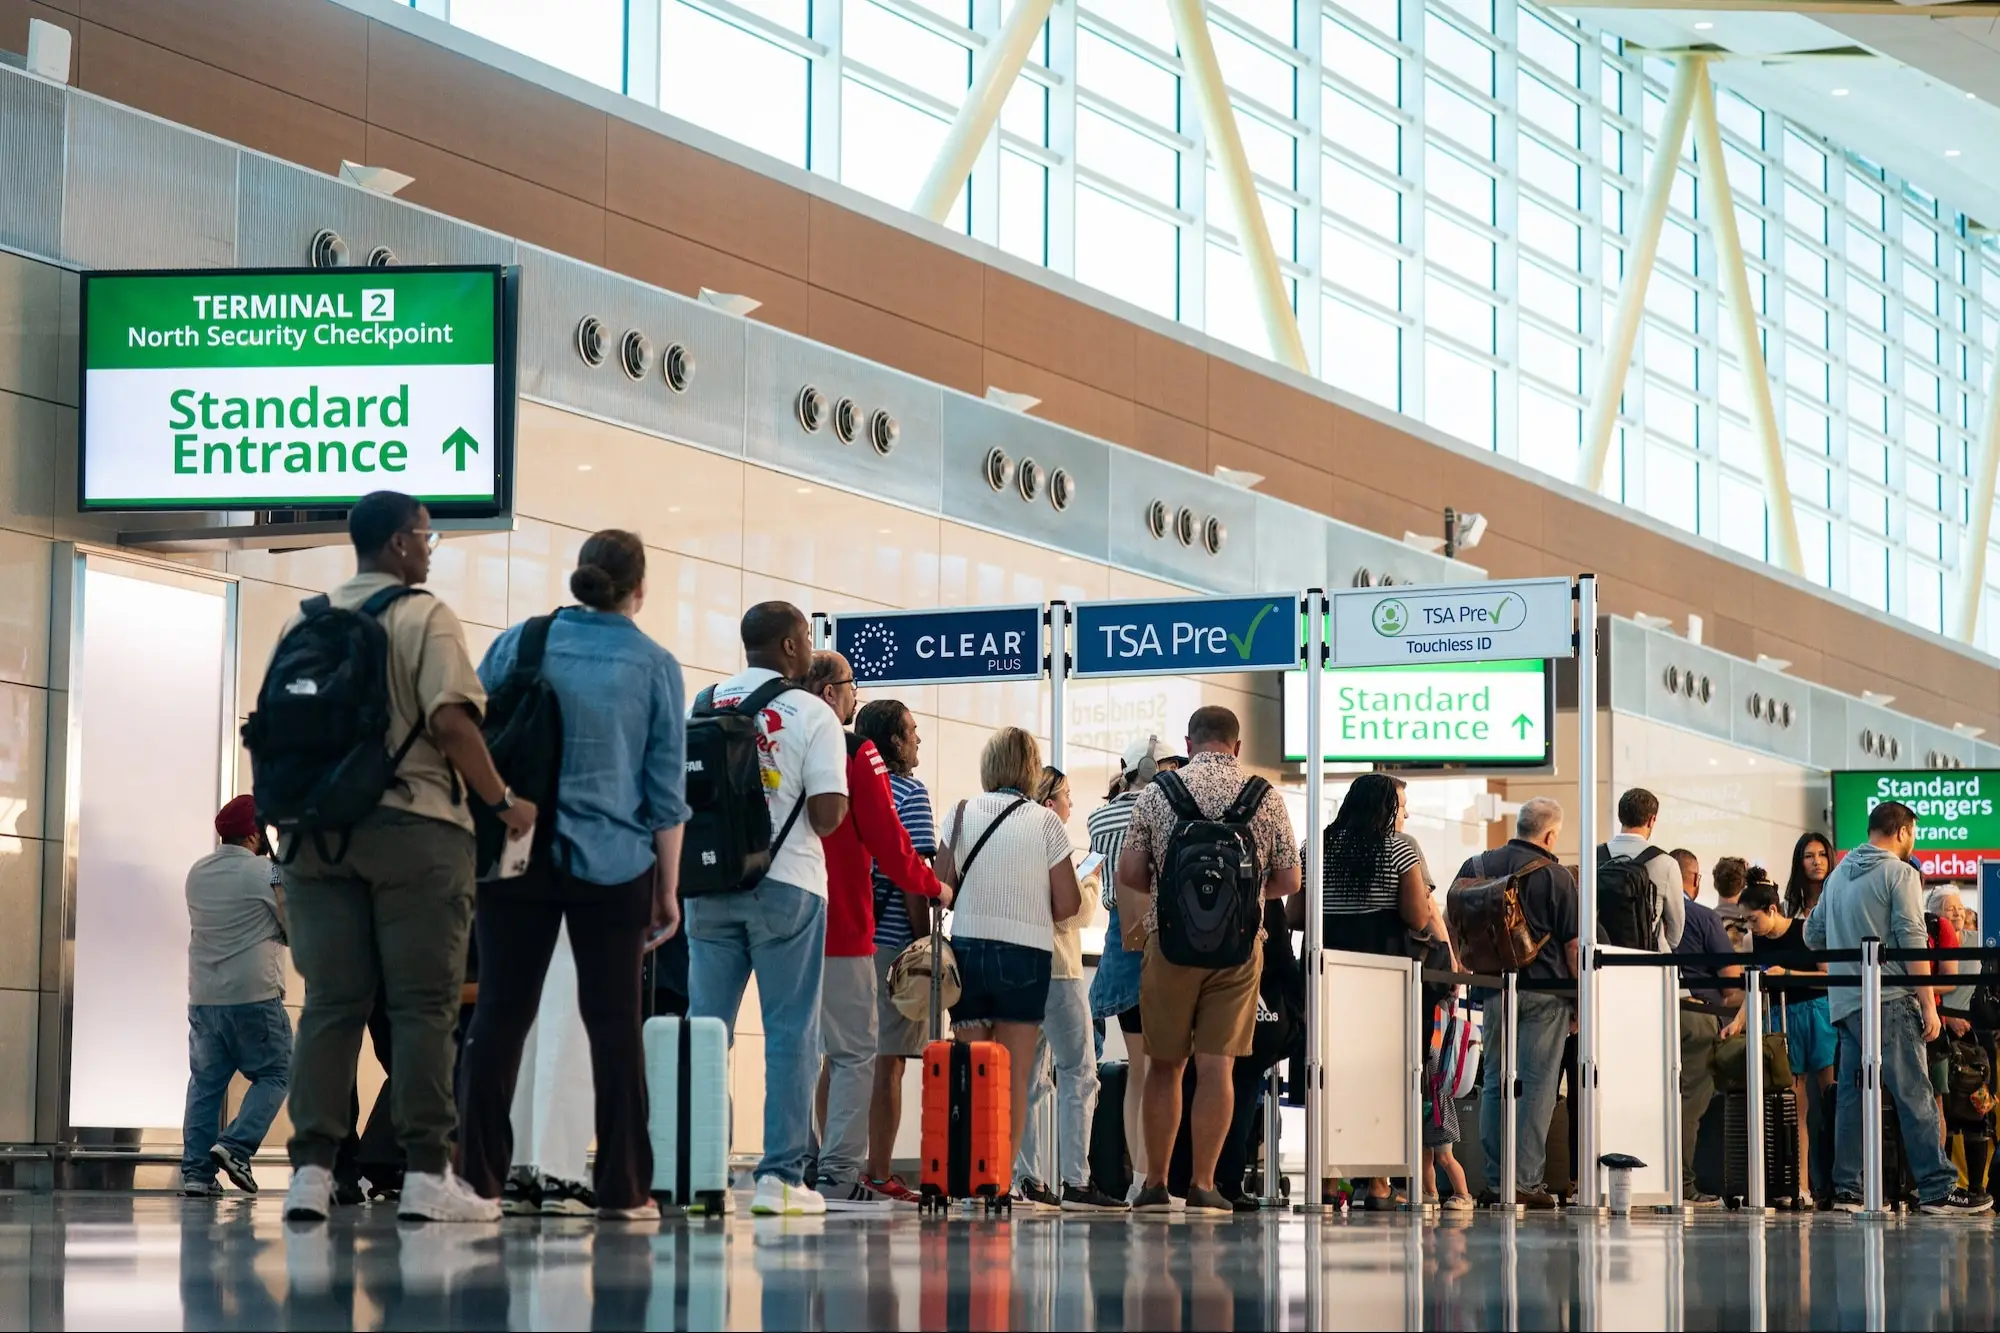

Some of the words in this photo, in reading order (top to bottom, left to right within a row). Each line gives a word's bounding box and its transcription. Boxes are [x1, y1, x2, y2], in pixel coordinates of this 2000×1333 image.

[193, 293, 353, 320] TERMINAL
[370, 293, 387, 317] 2
[128, 325, 199, 348] North
[207, 324, 307, 351] Security
[313, 322, 453, 350] Checkpoint
[169, 384, 409, 430] Standard
[174, 433, 408, 474] Entrance
[1423, 607, 1455, 624] TSA
[1459, 606, 1488, 622] Pre
[915, 631, 1021, 659] CLEAR
[1098, 623, 1163, 658] TSA
[1172, 622, 1228, 655] Pre
[1406, 638, 1473, 654] Touchless
[1477, 637, 1492, 650] ID
[988, 658, 1021, 671] PLUS
[1338, 686, 1490, 711] Standard
[1342, 715, 1490, 740] Entrance
[1877, 776, 1980, 797] Standard
[1866, 796, 1993, 821] Psengers
[1914, 825, 1968, 841] trance
